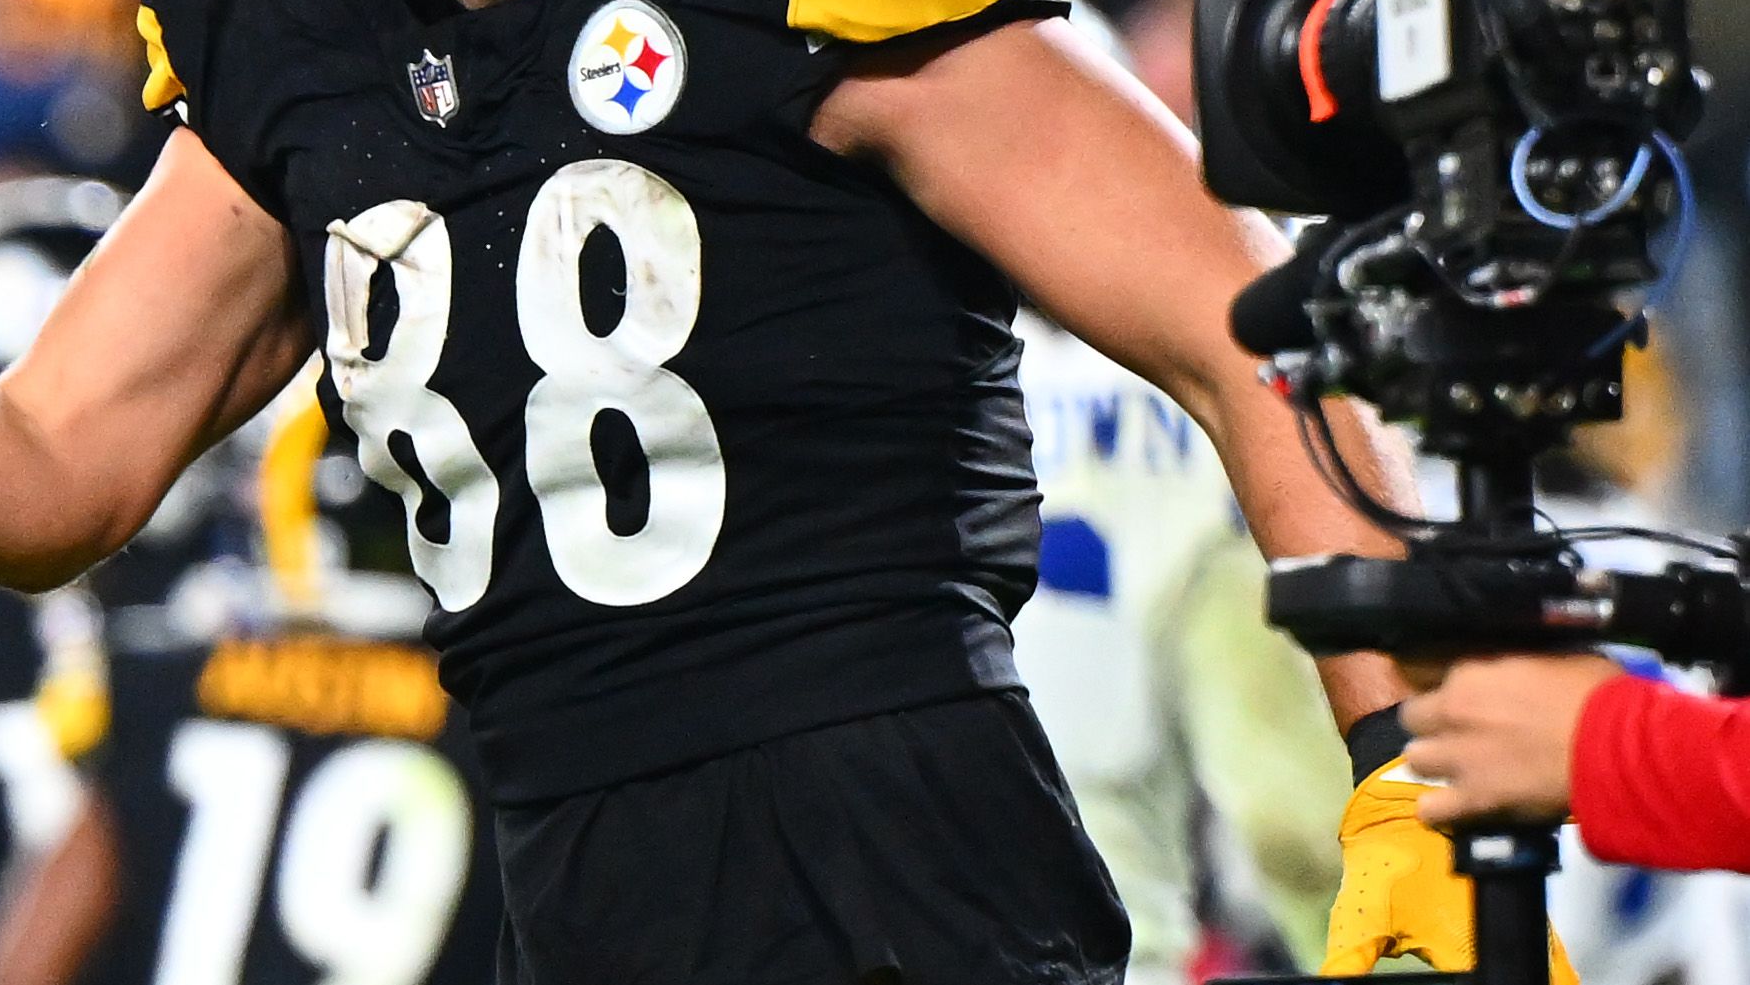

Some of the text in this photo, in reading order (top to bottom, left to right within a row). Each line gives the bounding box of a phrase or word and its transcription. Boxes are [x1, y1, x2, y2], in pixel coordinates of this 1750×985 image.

[420, 80, 453, 114] NFL
[580, 62, 621, 83] Steelers
[323, 158, 726, 613] 88
[152, 718, 474, 985] 19
